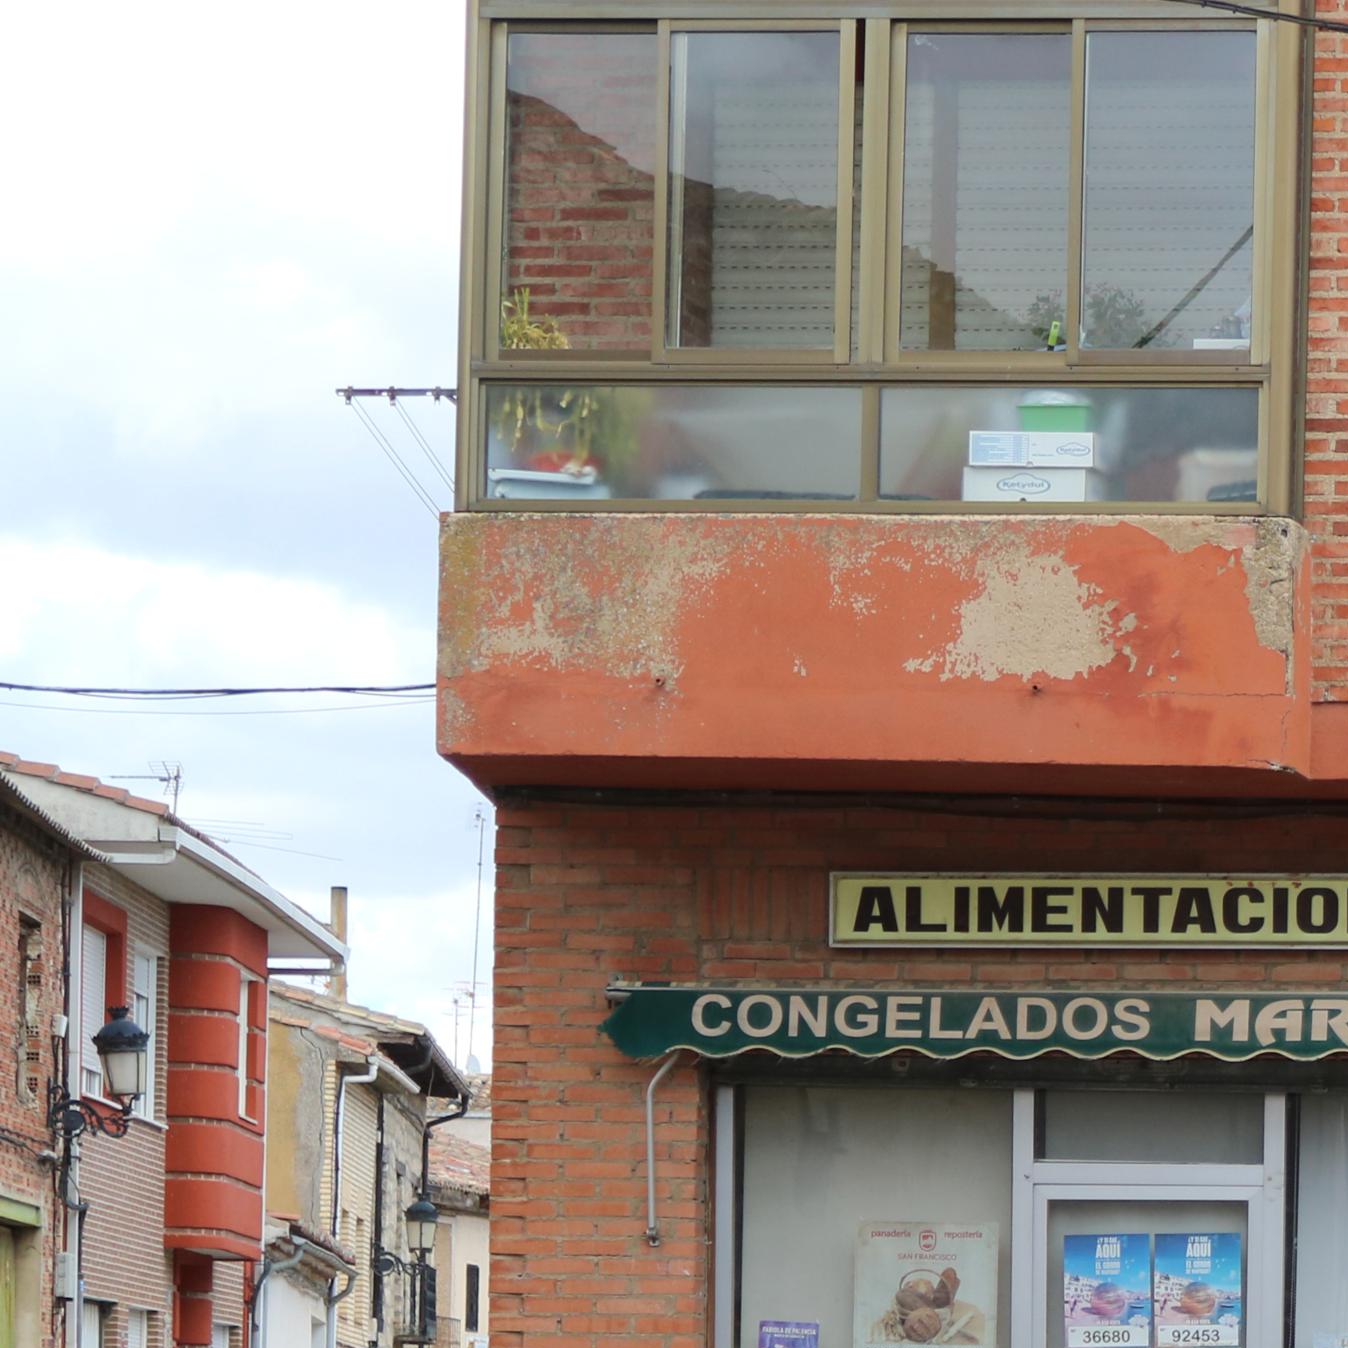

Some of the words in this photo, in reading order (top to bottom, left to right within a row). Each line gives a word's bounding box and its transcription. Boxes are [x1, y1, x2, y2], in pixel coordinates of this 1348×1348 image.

[691, 994, 1151, 1042] CONGELADOS
[915, 1253, 957, 1261] FRANCISCO
[1083, 1330, 1131, 1343] 36680
[1172, 1329, 1220, 1343] 92453
